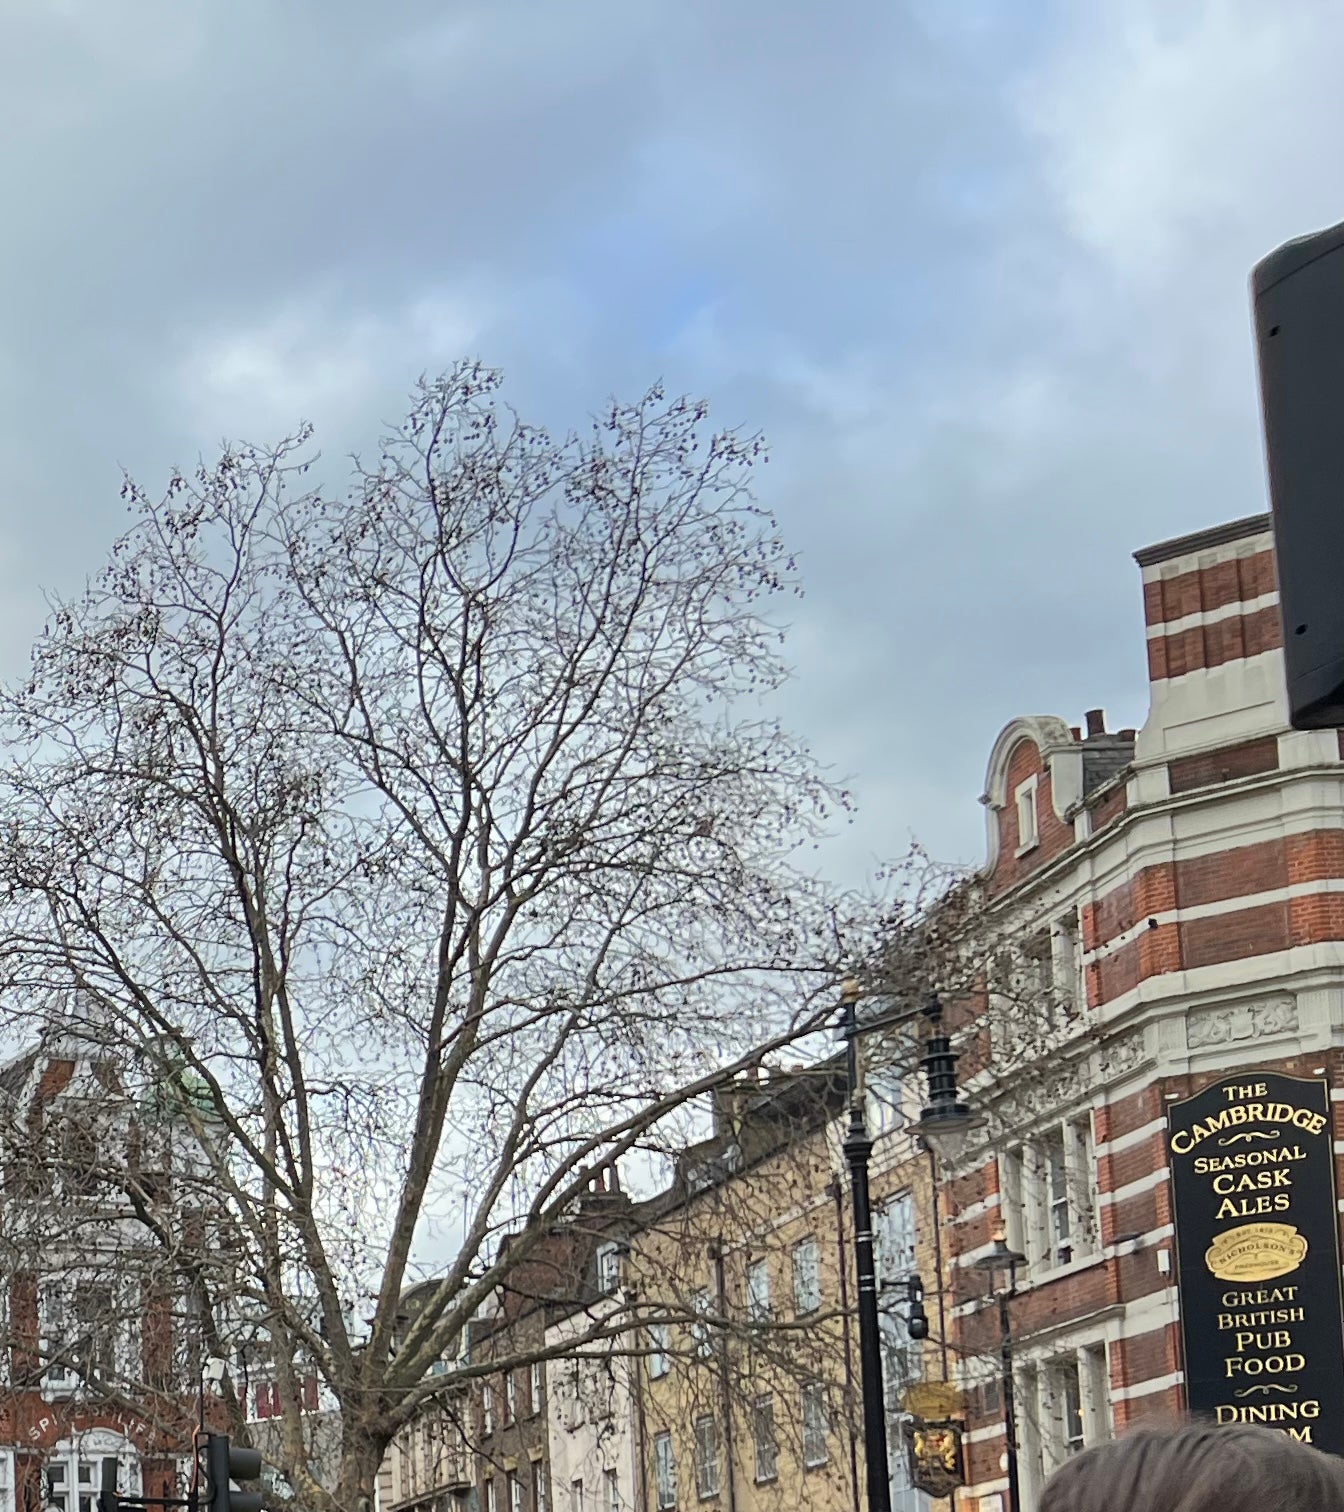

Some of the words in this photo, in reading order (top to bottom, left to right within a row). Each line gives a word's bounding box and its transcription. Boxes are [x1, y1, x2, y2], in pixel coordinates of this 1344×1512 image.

[1222, 1082, 1268, 1101] THE
[1170, 1102, 1328, 1154] CAMBRIDGE
[1194, 1145, 1307, 1174] SEASONAL
[1212, 1168, 1292, 1195] CASK
[1215, 1193, 1290, 1220] ALES
[1222, 1286, 1299, 1308] GREAT
[1217, 1307, 1305, 1330] BRITISH
[1235, 1330, 1291, 1353] PUB
[1224, 1353, 1306, 1378] FOOD
[1214, 1400, 1321, 1426] DINING
